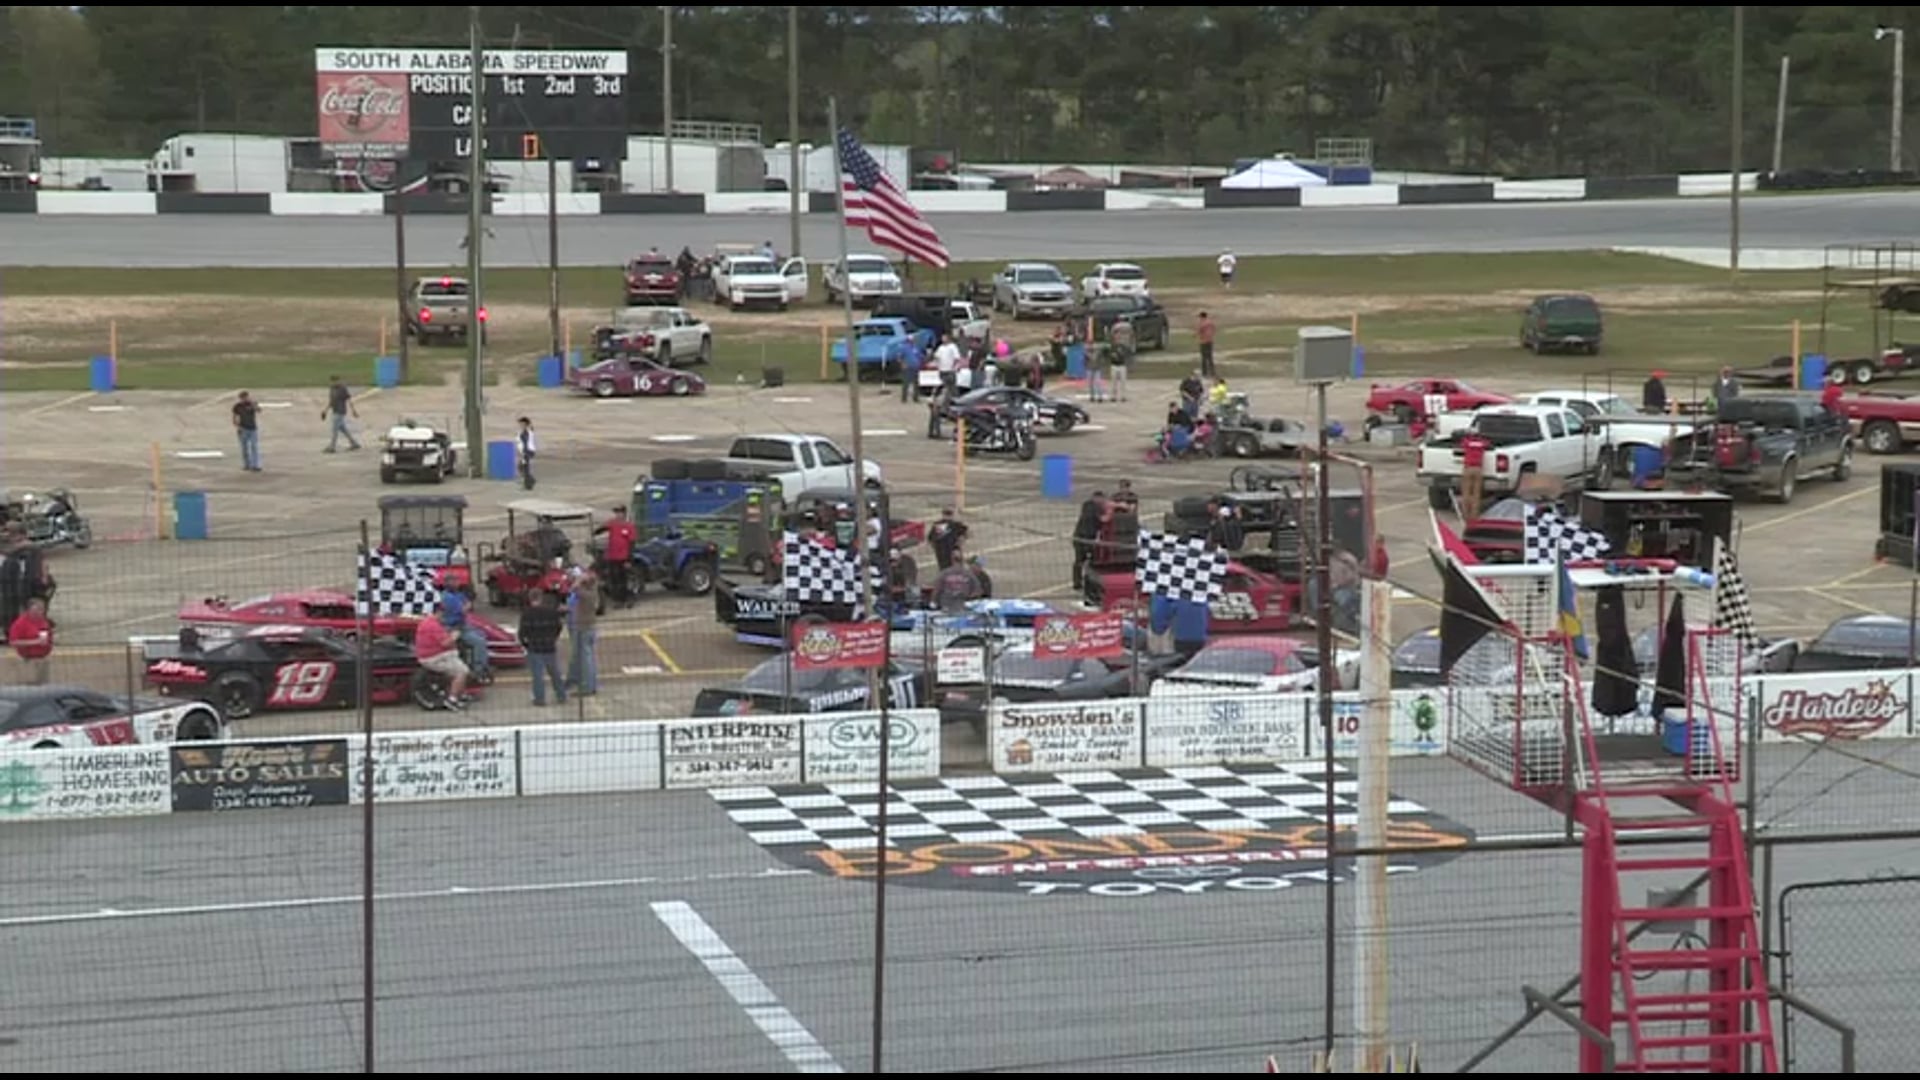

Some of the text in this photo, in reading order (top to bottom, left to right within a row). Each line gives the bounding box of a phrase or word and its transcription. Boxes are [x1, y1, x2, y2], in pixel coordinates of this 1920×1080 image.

[334, 52, 400, 69] SOUTH
[513, 54, 609, 70] SPEEDWAY
[503, 77, 525, 94] 1st
[545, 77, 575, 94] 2nd
[594, 77, 621, 94] 3rd
[633, 373, 652, 391] 16
[268, 661, 337, 703] 18
[1002, 706, 1134, 728] Snowden's
[671, 721, 797, 741] ENTERPRISE
[58, 751, 168, 771] TIMBERLINE
[454, 761, 499, 781] Grill
[173, 763, 345, 784] AUTO SALES
